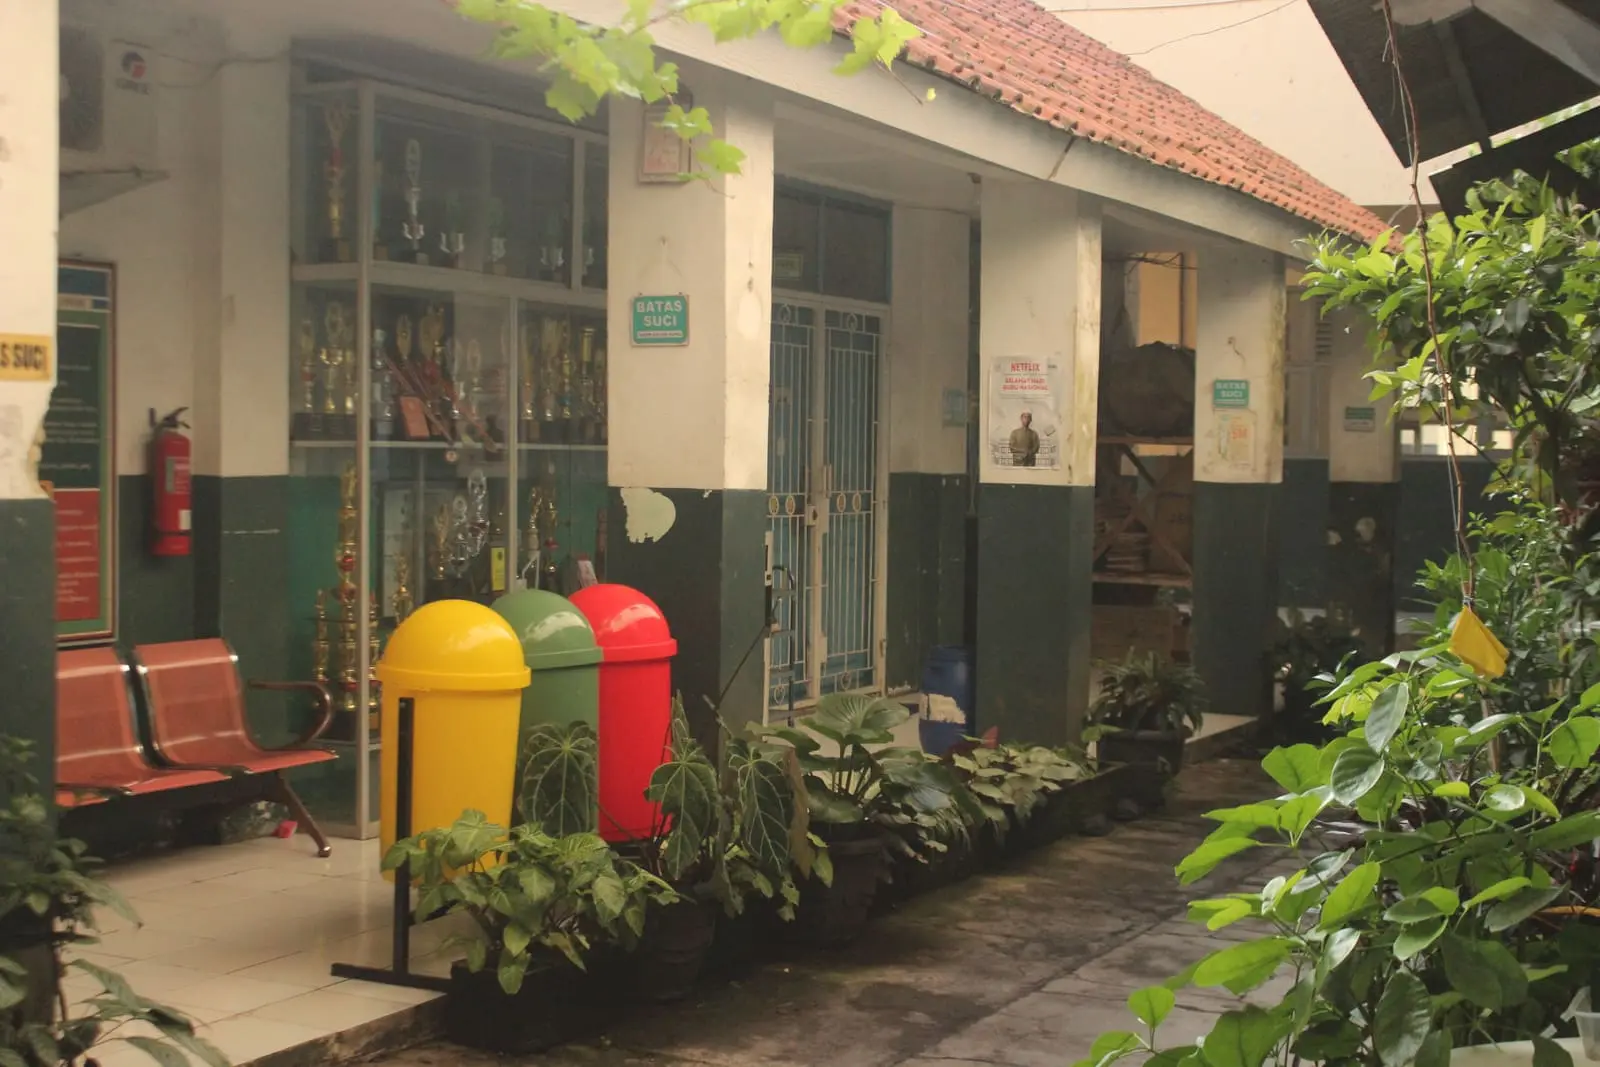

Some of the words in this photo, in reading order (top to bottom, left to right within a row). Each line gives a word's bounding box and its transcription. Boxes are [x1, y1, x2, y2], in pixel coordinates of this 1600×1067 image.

[636, 300, 683, 313] BATAS
[643, 315, 678, 327] SUCI
[13, 343, 48, 370] SUCI
[1010, 362, 1041, 373] NETFLIX
[1221, 390, 1243, 398] SUCI
